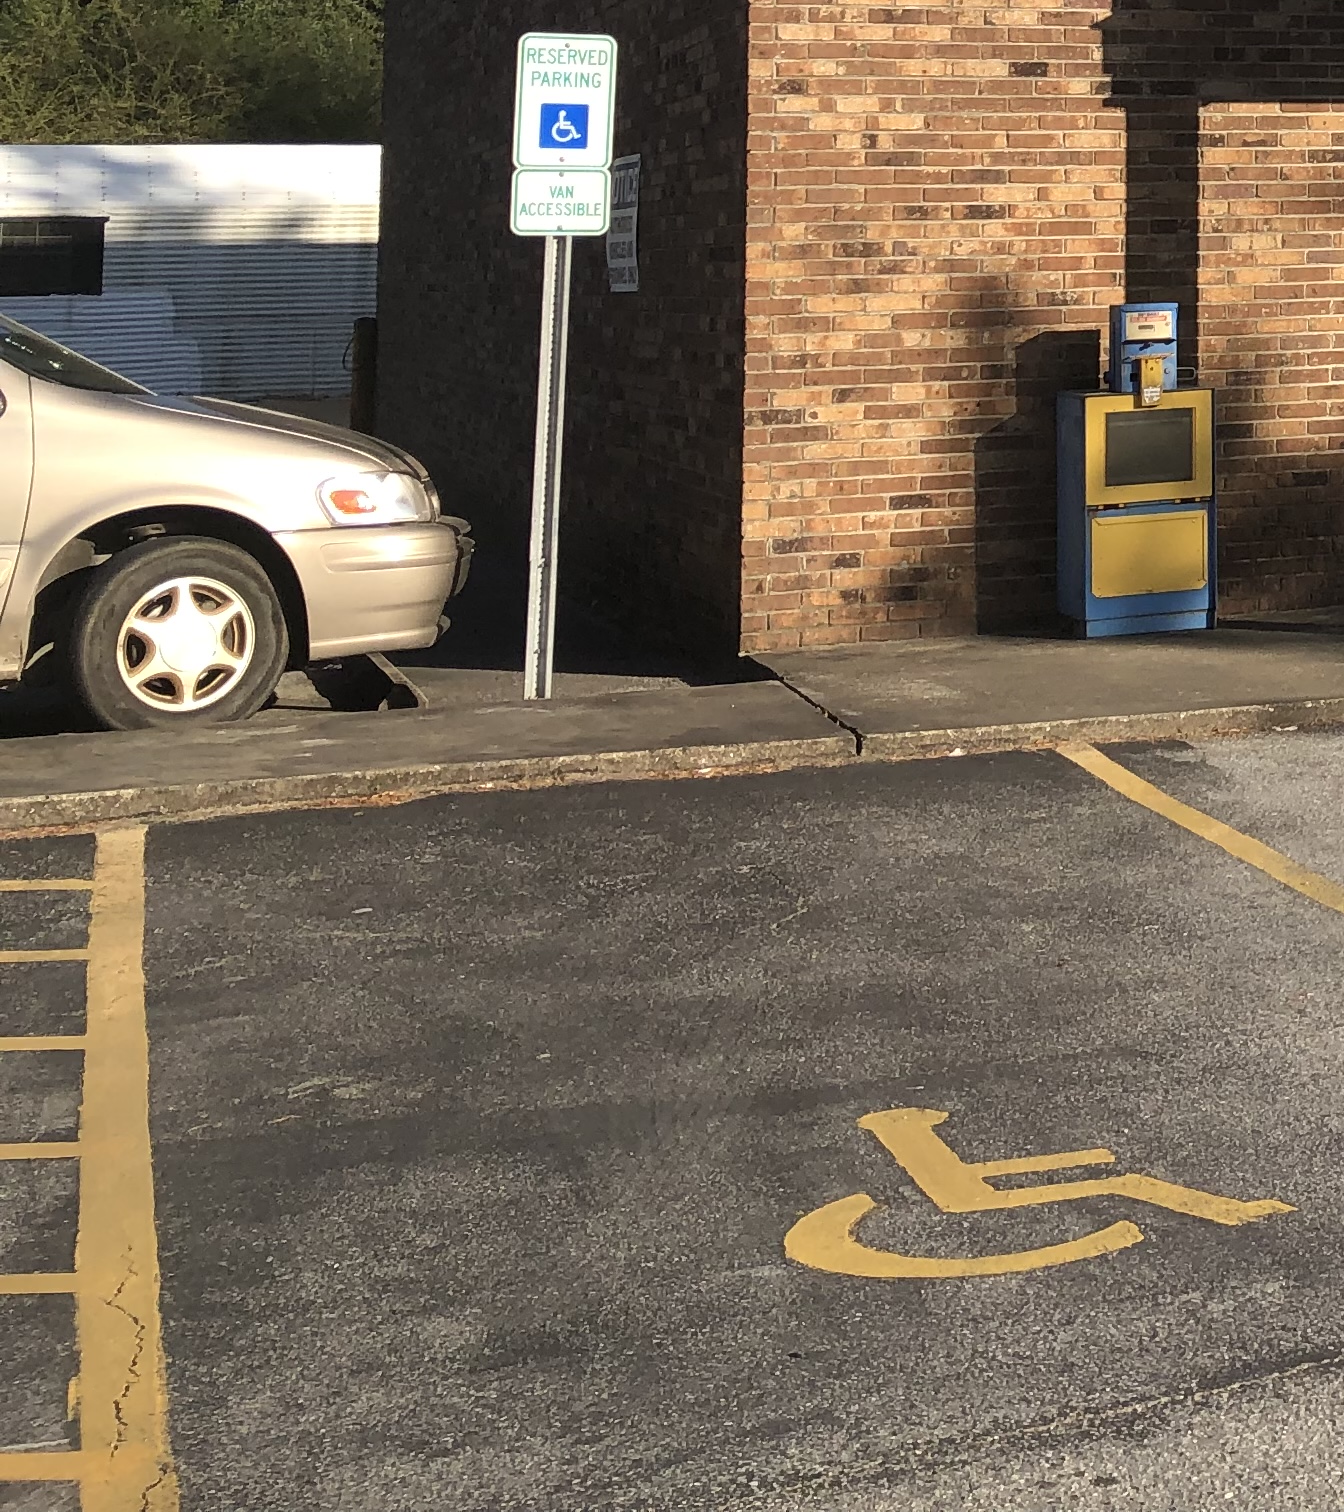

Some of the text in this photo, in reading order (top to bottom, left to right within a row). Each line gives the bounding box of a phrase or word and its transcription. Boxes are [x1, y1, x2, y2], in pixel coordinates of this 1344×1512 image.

[527, 48, 608, 65] RESERVED
[531, 71, 601, 88] PARKING
[549, 186, 574, 198] VAN
[519, 203, 601, 216] ACCESSIBLE
